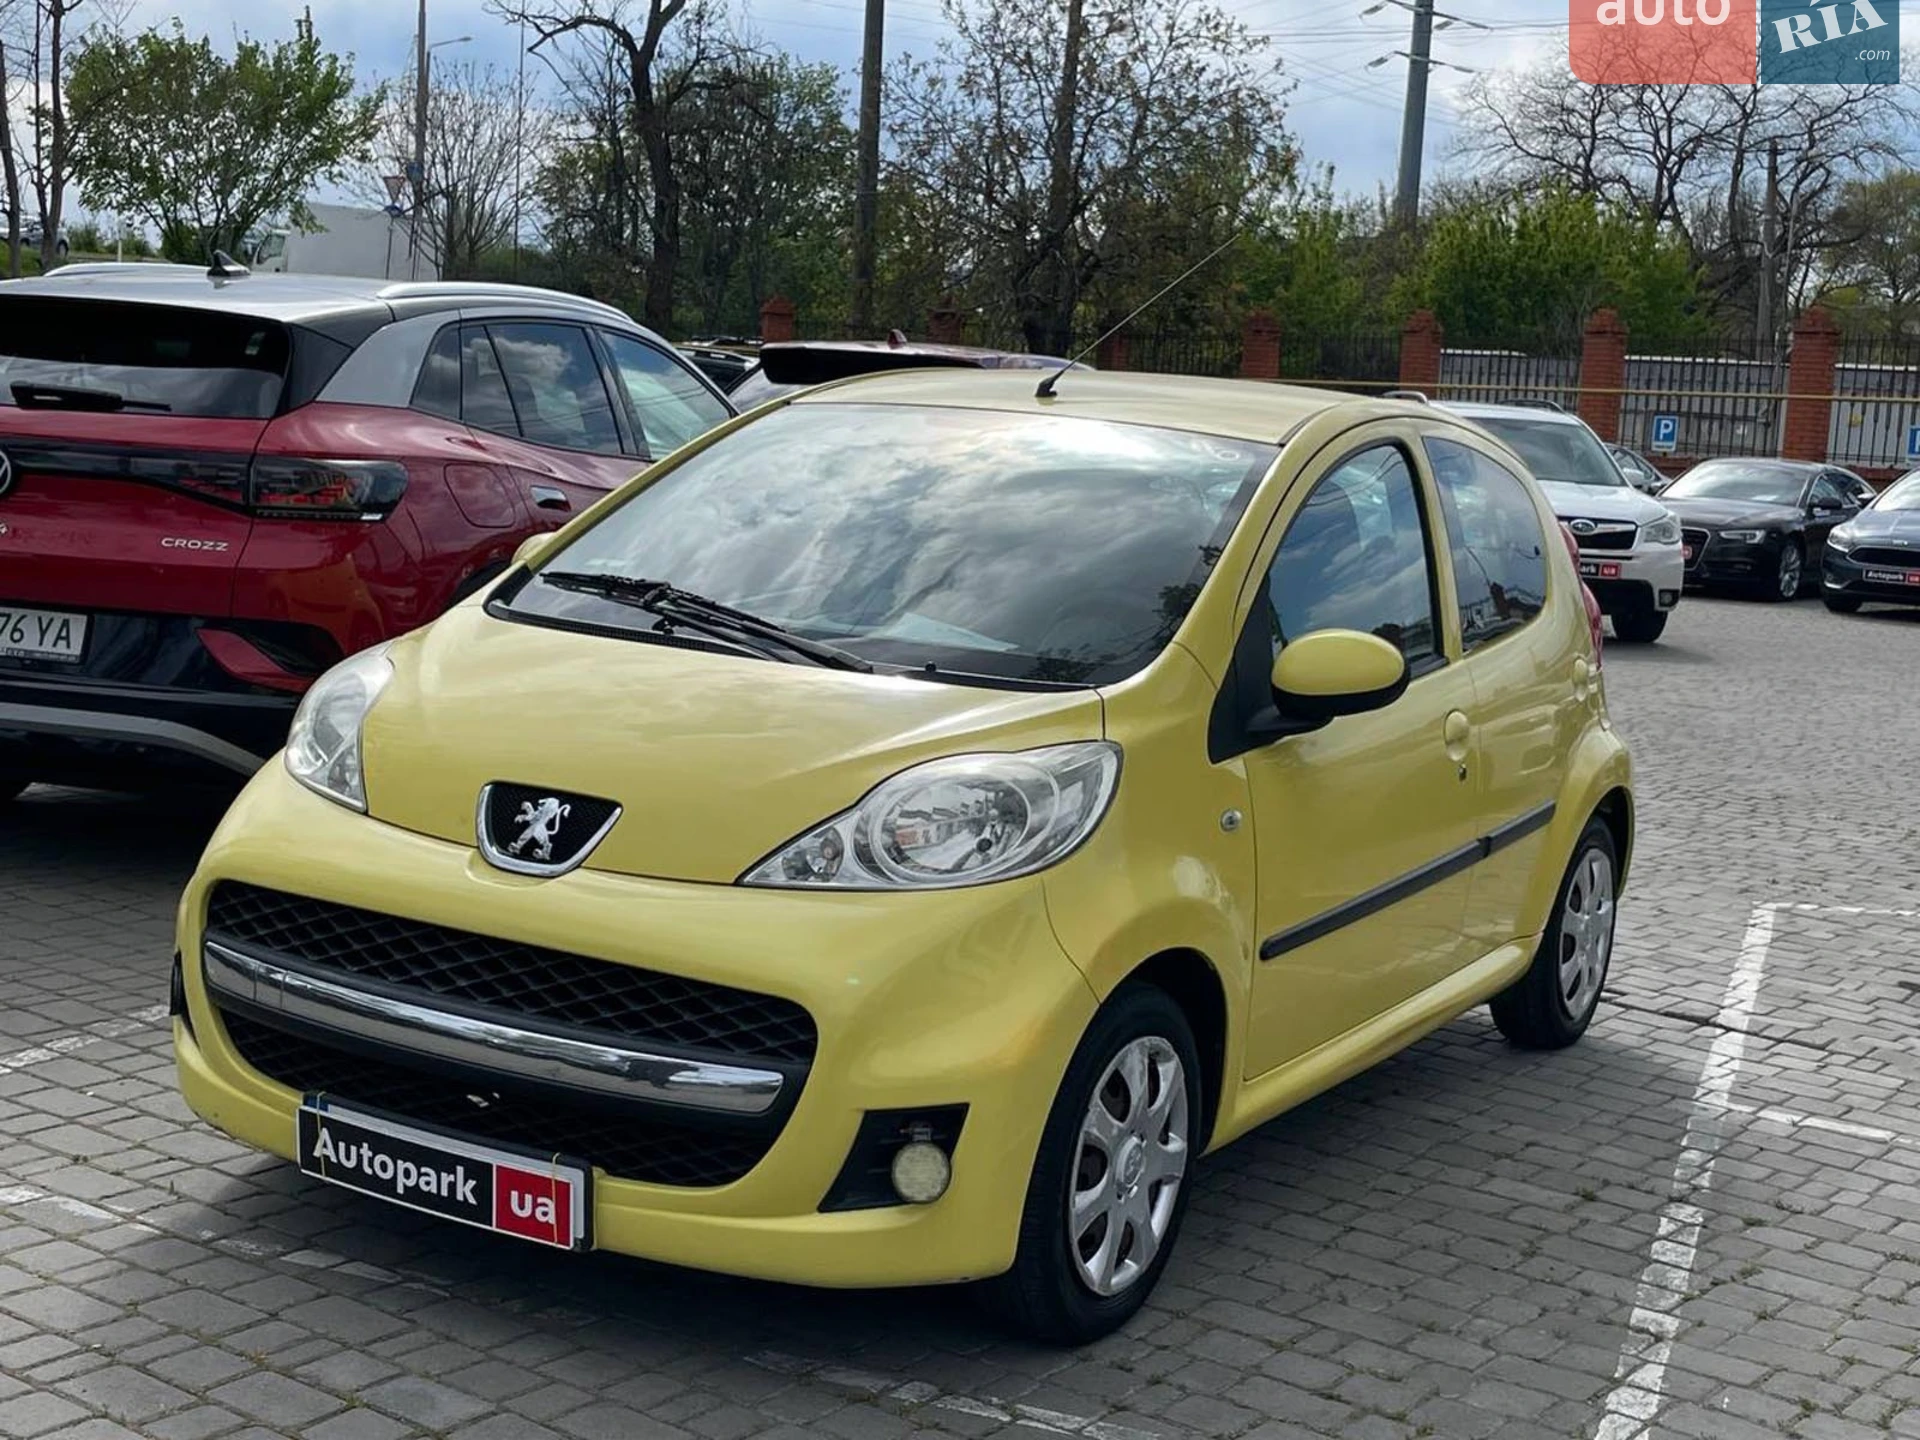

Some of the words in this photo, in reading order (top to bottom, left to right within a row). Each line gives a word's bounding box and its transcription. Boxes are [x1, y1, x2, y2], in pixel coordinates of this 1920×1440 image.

[1659, 419, 1673, 440] P
[161, 537, 229, 551] CROZZ
[37, 615, 71, 650] YA
[313, 1127, 478, 1206] Autopark
[509, 1189, 556, 1226] ua
